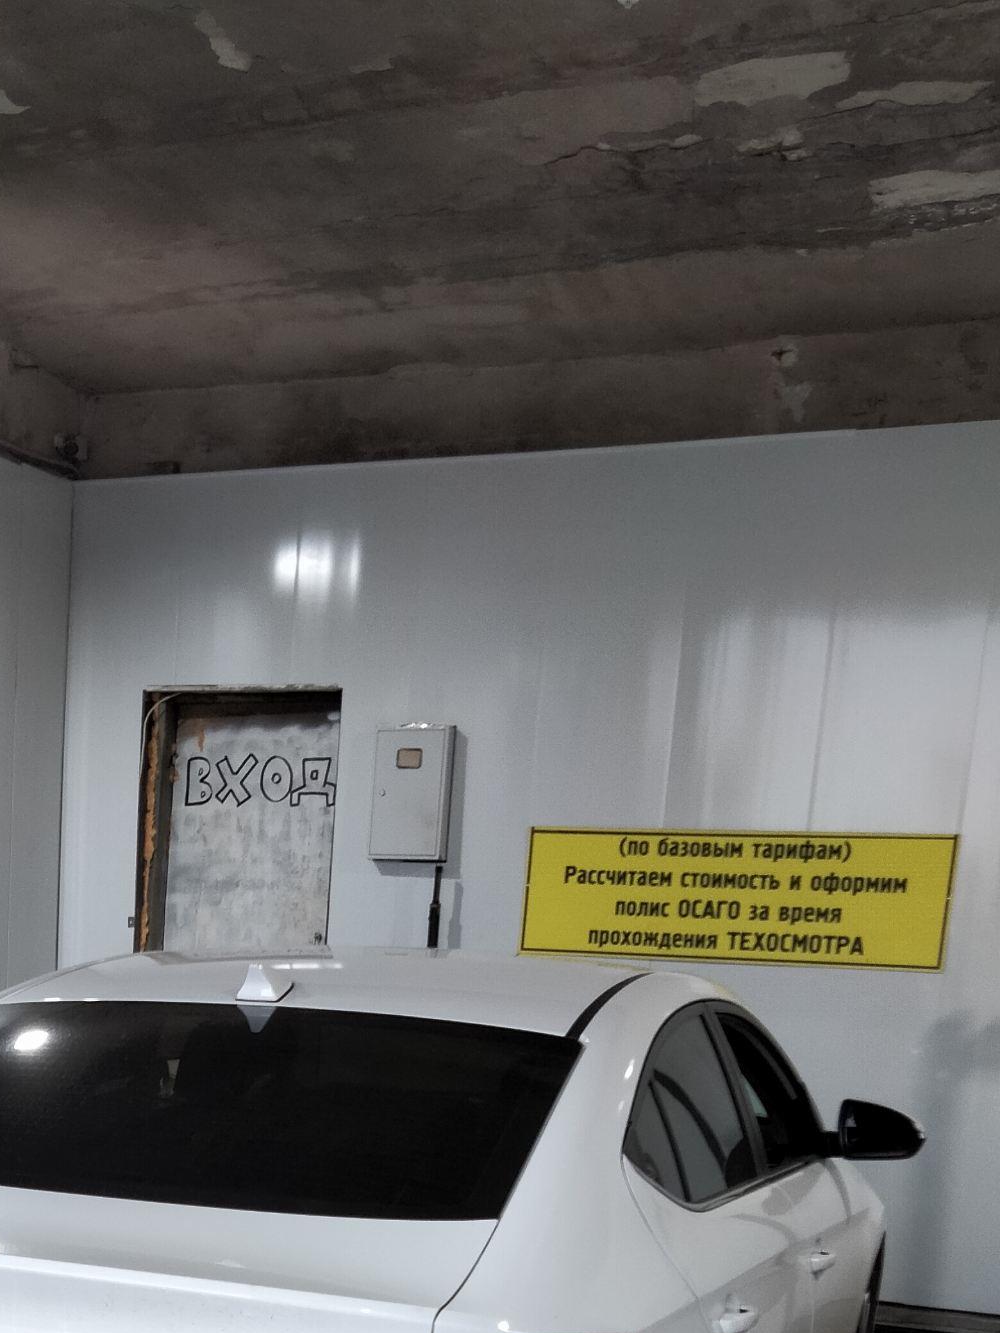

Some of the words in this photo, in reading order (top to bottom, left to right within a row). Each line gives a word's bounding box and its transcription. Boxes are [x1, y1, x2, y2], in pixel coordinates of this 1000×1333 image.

[185, 753, 336, 807] ВХОД
[618, 838, 649, 858] (по
[658, 837, 743, 859] базовым
[752, 841, 852, 863] тарифам)
[564, 865, 672, 888] Рассчитаем
[680, 872, 780, 891] стоимость
[789, 875, 800, 890] и
[810, 874, 907, 895] оформим
[614, 900, 669, 919] полис
[678, 899, 741, 921] ОСАГО
[748, 905, 769, 922] за
[779, 906, 842, 925] время
[588, 928, 718, 951] прохождения
[726, 932, 865, 956] ТЕХОСМОТРА
